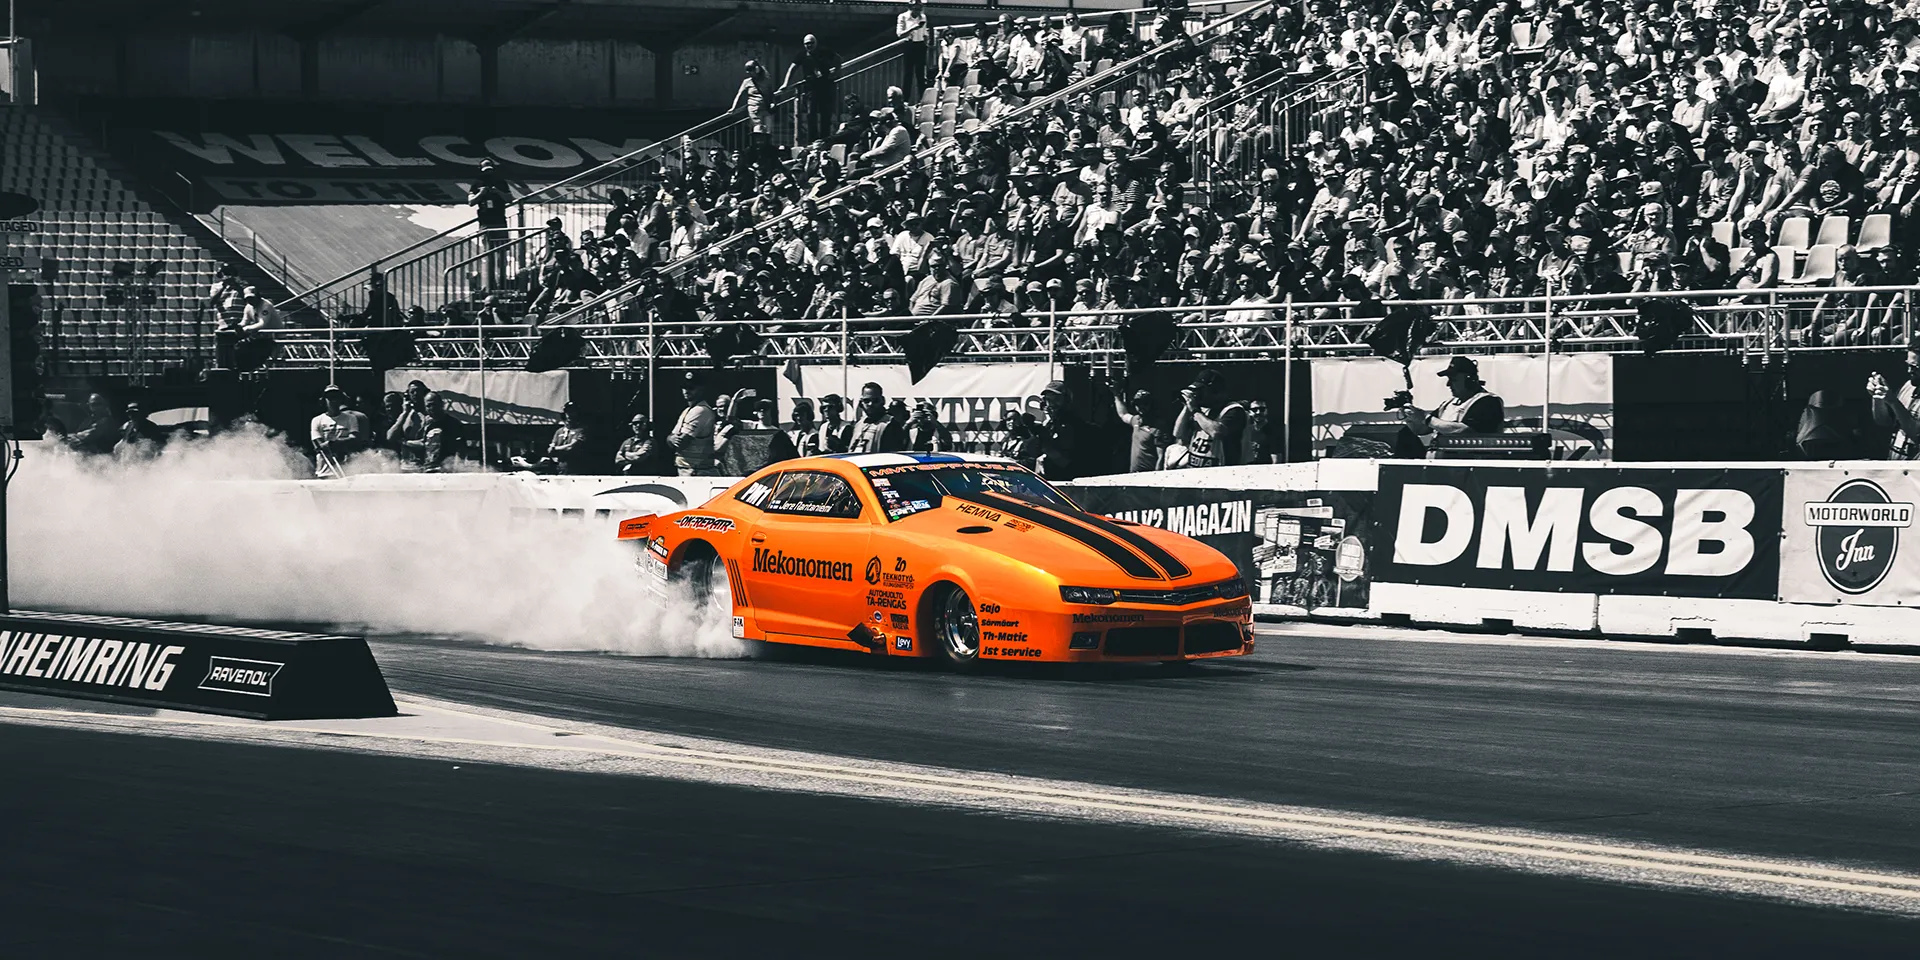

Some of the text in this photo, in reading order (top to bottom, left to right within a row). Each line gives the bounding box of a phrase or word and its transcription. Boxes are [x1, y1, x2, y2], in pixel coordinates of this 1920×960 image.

[153, 130, 705, 170] WELCOM
[225, 180, 315, 199] TO
[329, 180, 453, 199] THE
[956, 503, 1002, 522] HEMIVA
[1167, 500, 1252, 537] MAGAZIN
[1809, 507, 1909, 522] MOTORWORLD
[1393, 484, 1756, 577] DMSB
[1836, 528, 1876, 571] Inn
[752, 547, 853, 582] Mekonomen
[866, 596, 907, 610] TA-RENGAS
[869, 589, 904, 600] AUTOHUOLTO
[980, 603, 1001, 614] Sajo
[1073, 613, 1145, 624] Mekonomen
[897, 636, 911, 649] Levy
[983, 631, 1028, 642] Th-Matic
[0, 631, 186, 691] NHEIMRING
[1001, 647, 1042, 657] service
[210, 666, 268, 686] RAVENOL
